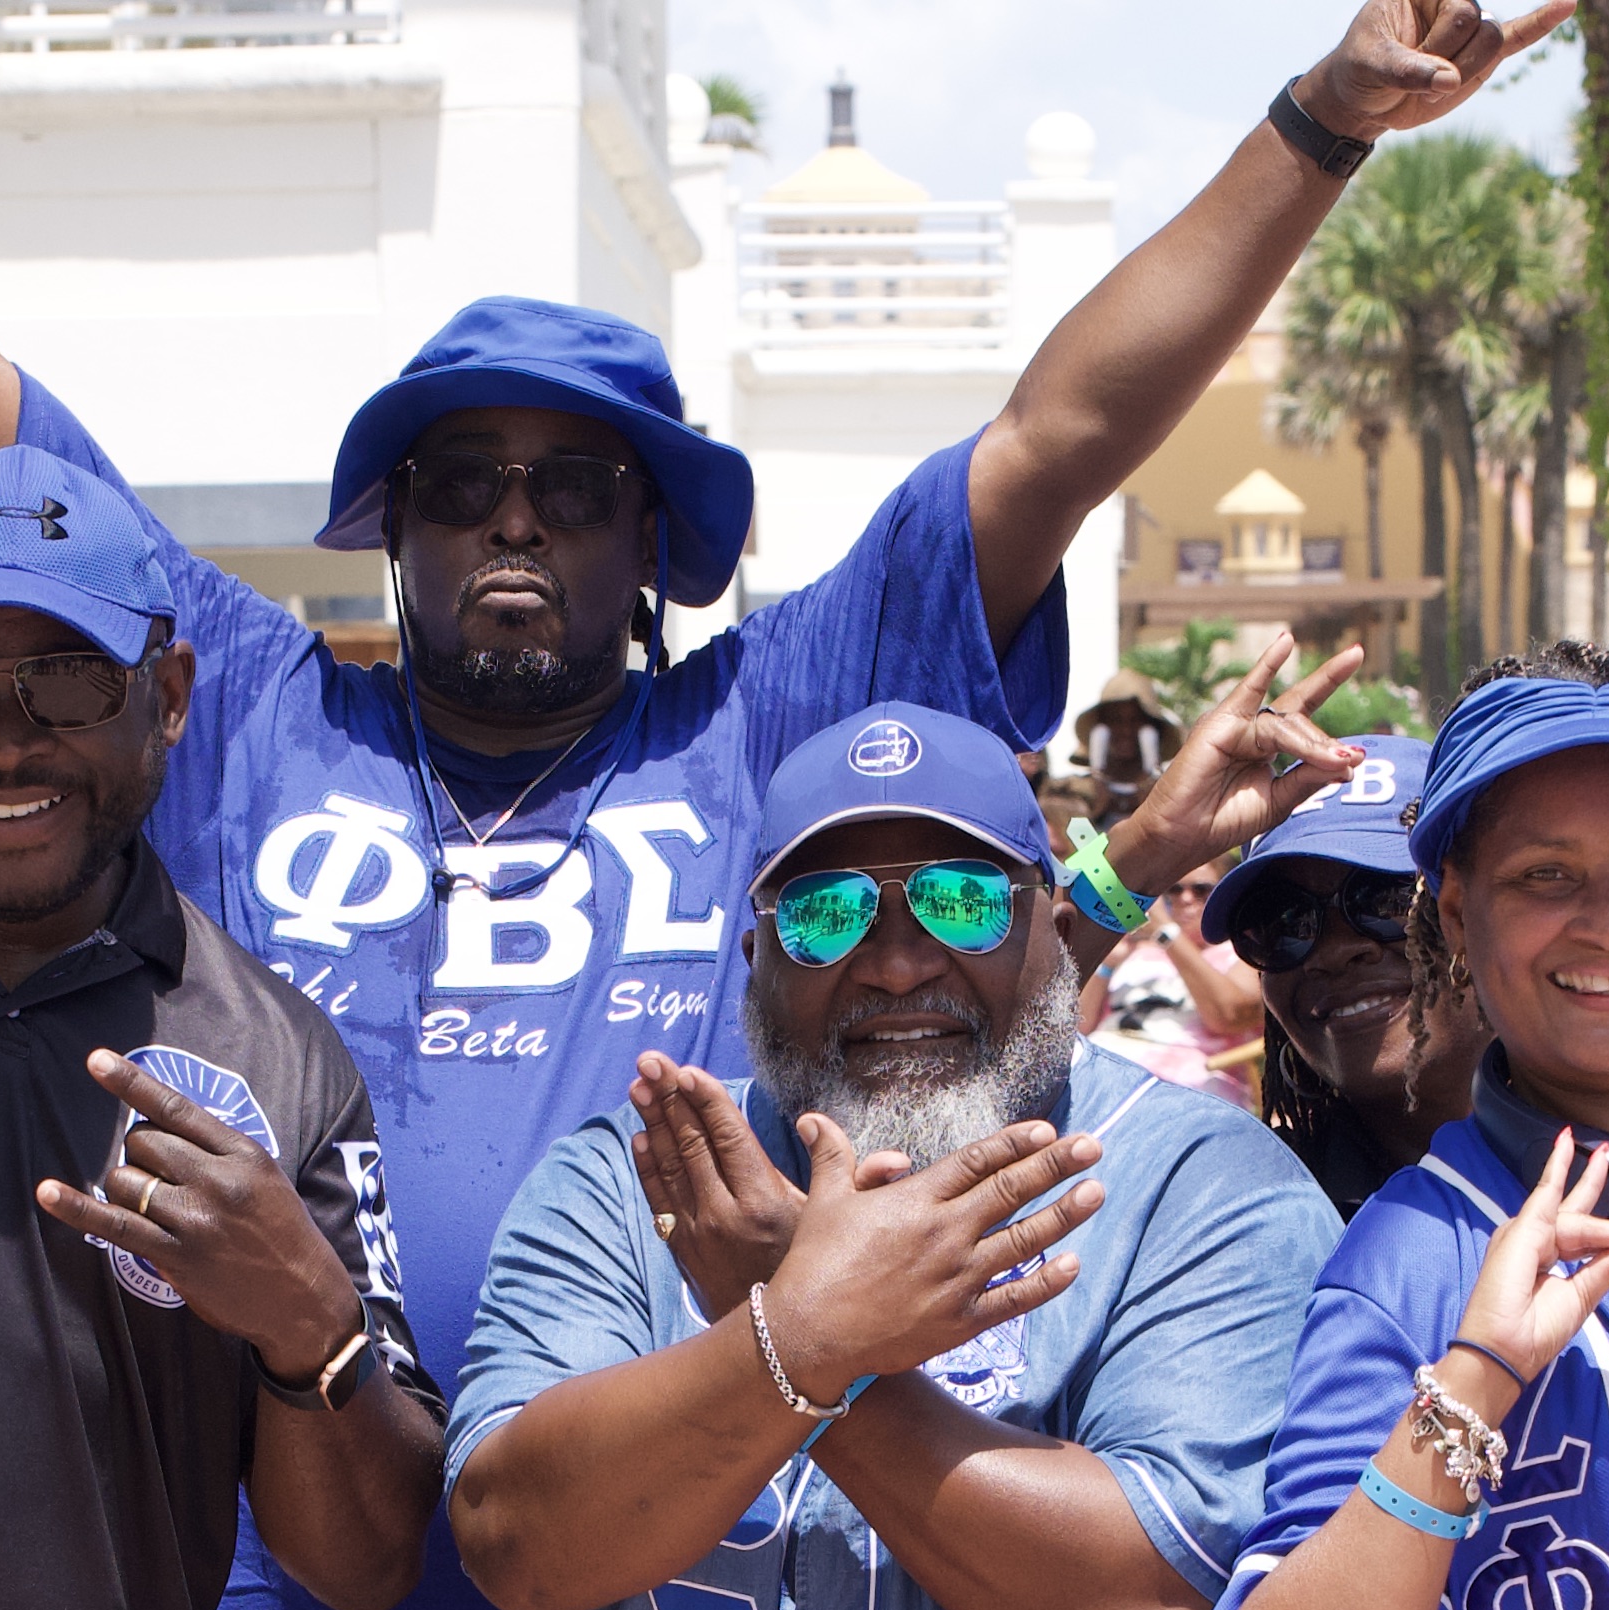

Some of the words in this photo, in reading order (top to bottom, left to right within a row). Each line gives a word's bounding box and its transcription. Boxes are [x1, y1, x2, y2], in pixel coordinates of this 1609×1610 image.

[418, 1009, 549, 1057] Beta
[607, 980, 710, 1032] Sigm
[117, 1253, 161, 1294] OUNDED
